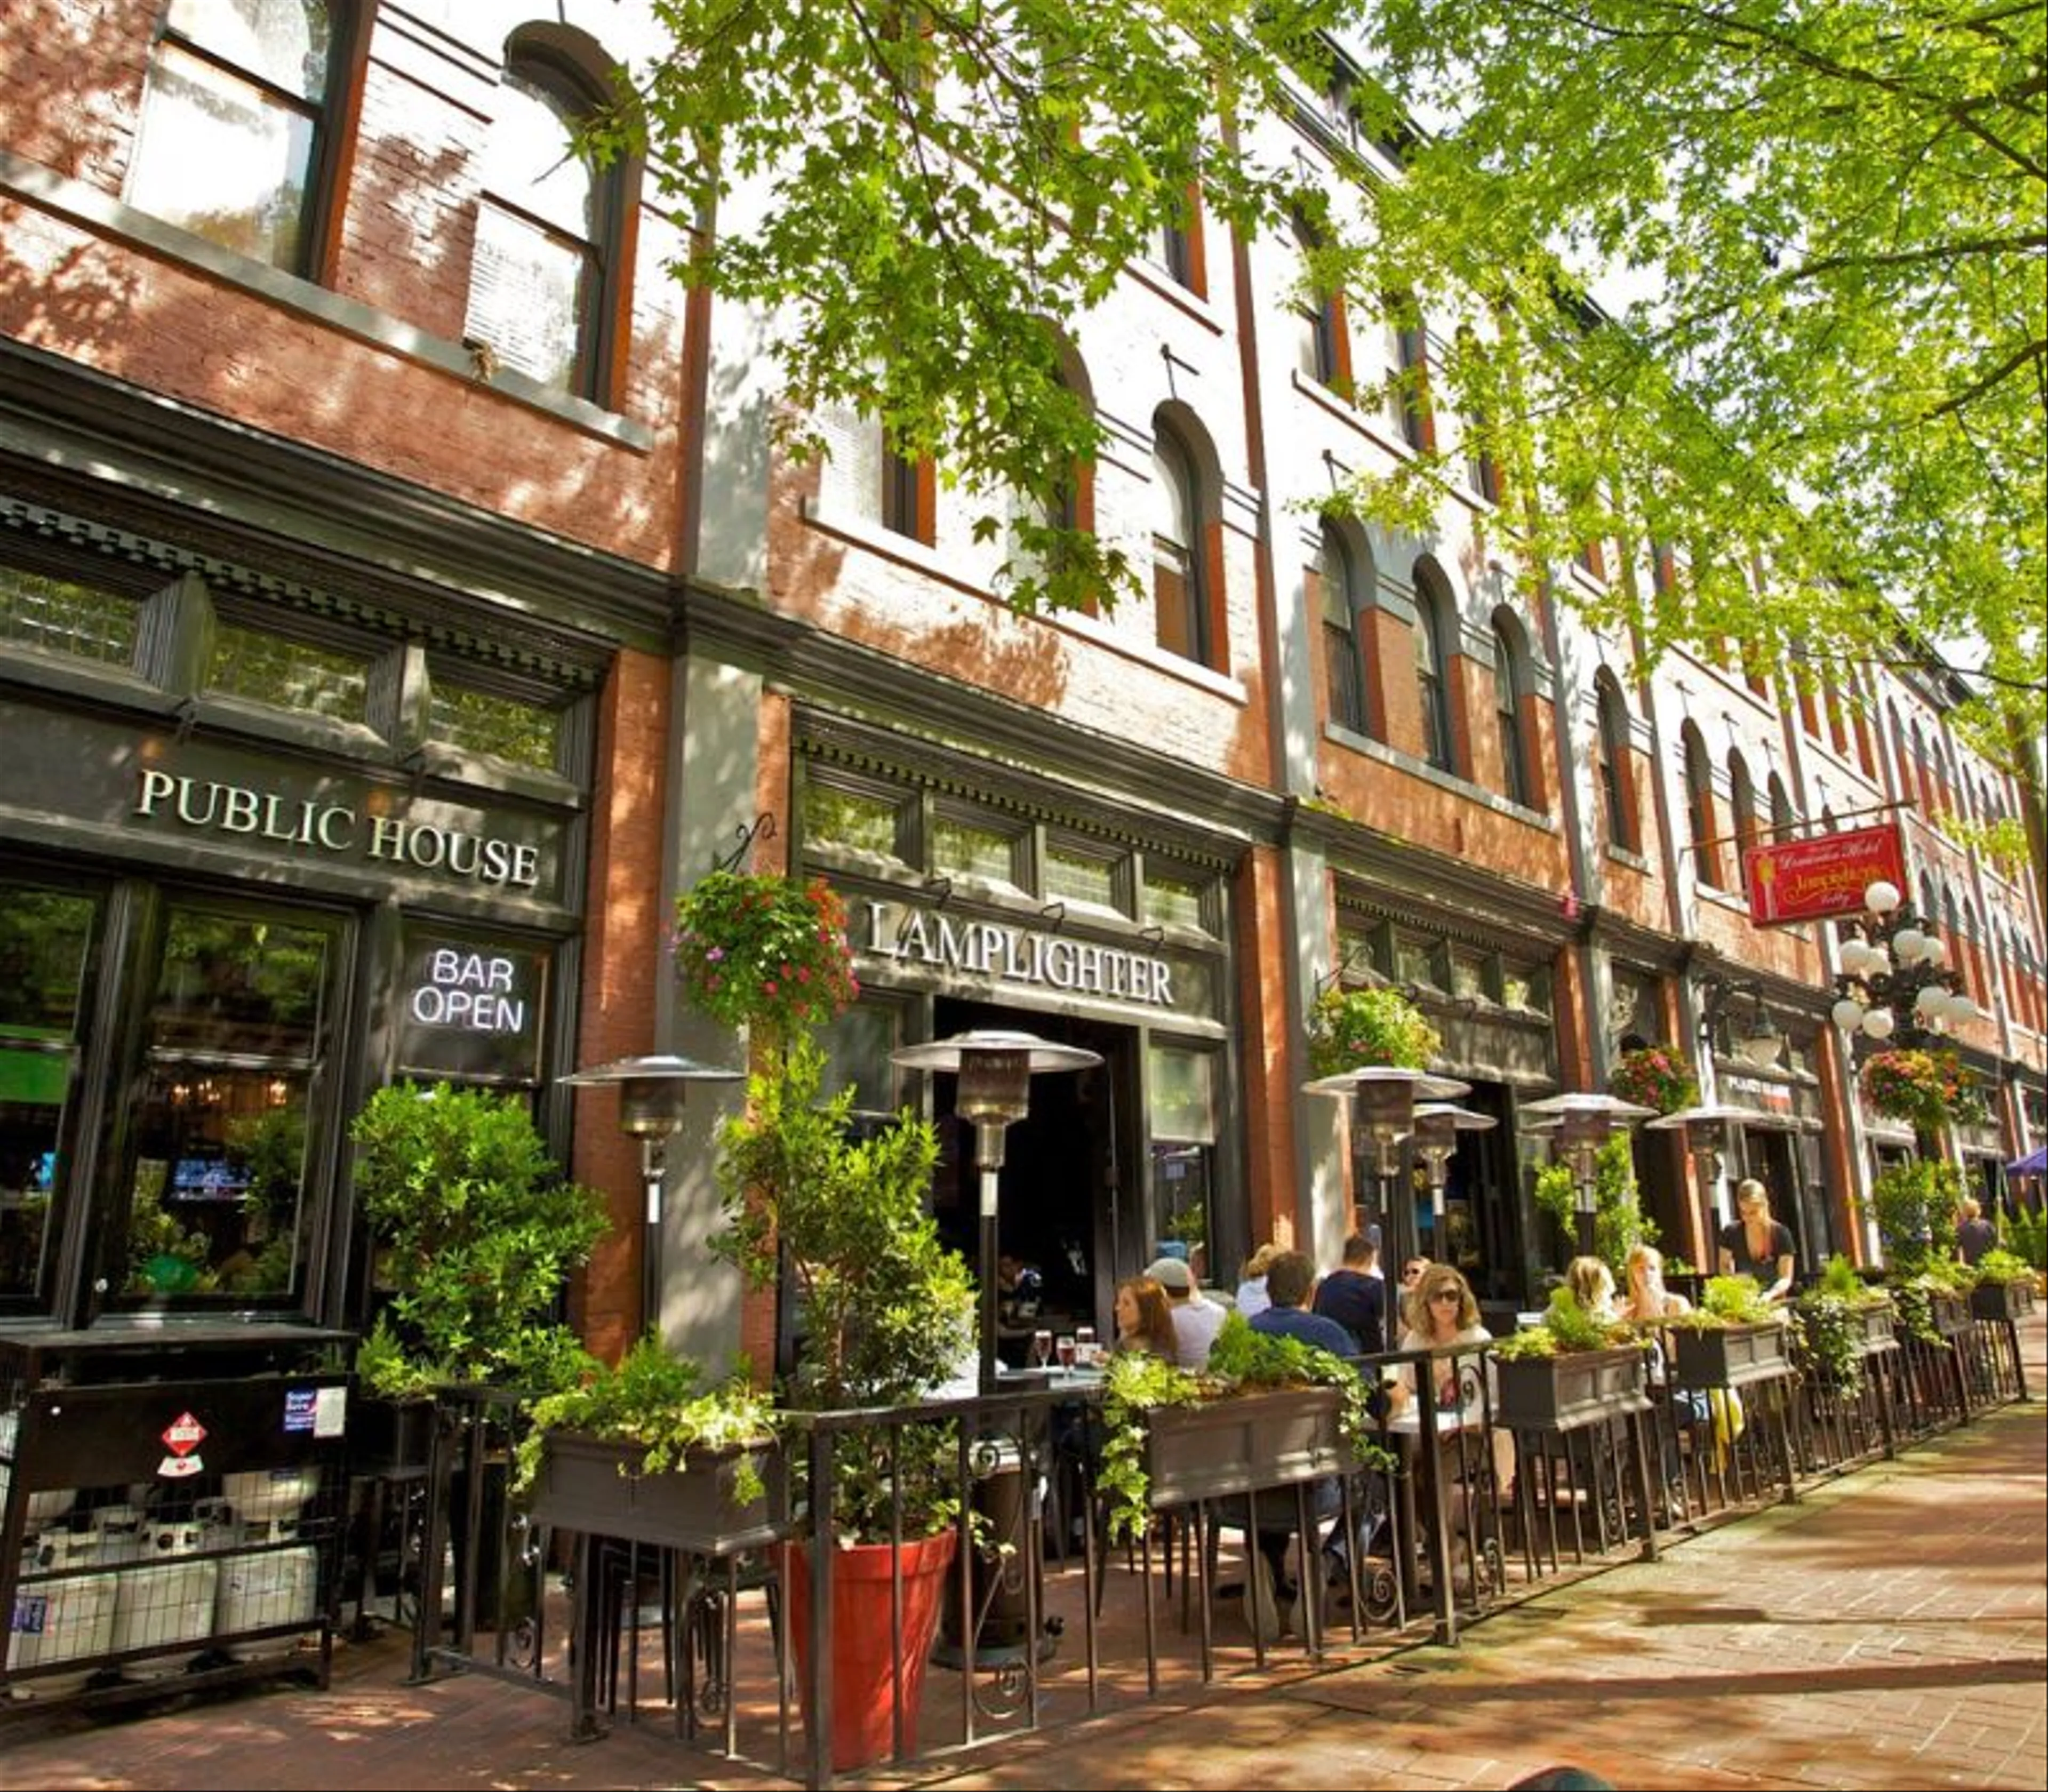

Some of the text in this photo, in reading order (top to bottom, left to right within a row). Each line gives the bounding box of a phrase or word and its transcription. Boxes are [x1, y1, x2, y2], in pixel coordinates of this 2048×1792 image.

[137, 769, 540, 887] PUBLIC HOUSE
[433, 948, 514, 993] BAR
[866, 902, 1174, 1004] LAMPLIGHTER
[413, 987, 524, 1034] OPEN
